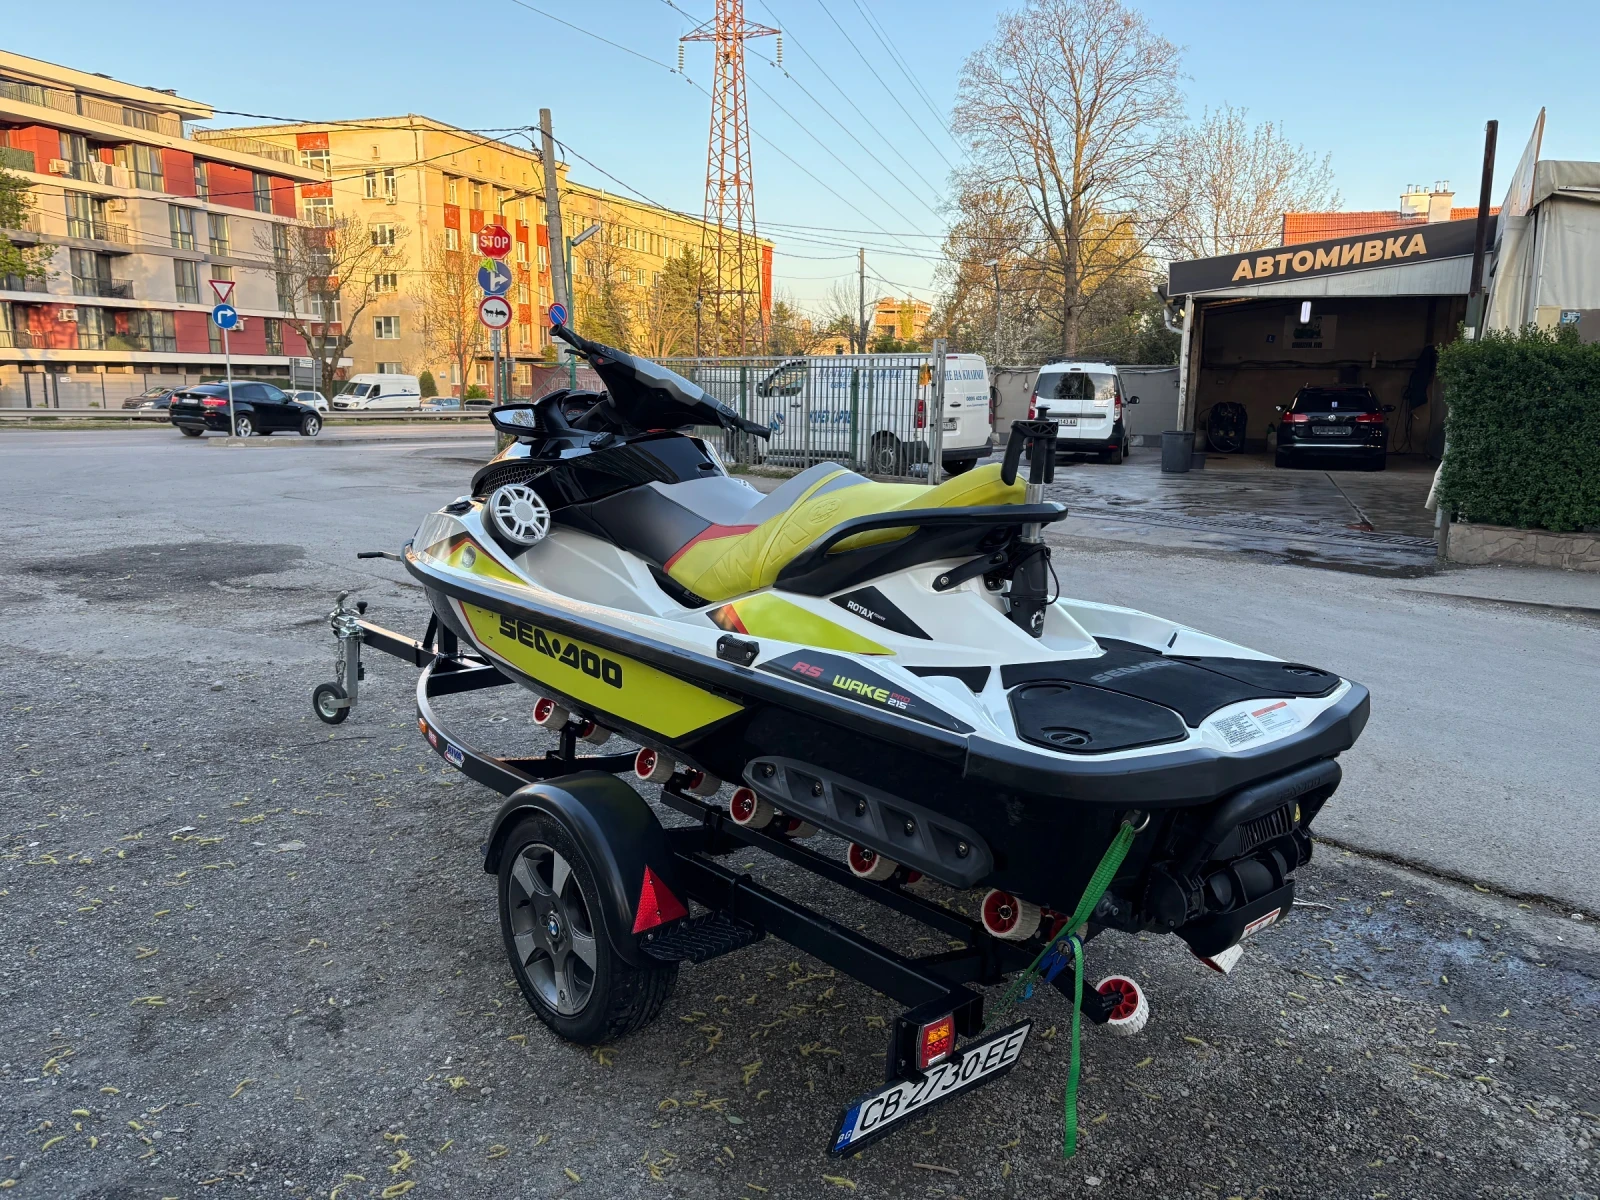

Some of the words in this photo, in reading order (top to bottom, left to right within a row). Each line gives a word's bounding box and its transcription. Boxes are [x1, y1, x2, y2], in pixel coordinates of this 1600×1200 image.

[480, 235, 509, 249] STOP
[1231, 233, 1427, 282] АВТОМИВКА
[847, 600, 875, 620] ROTAX
[792, 661, 824, 678] RS
[832, 674, 890, 703] WAKE
[891, 692, 911, 703] PRO
[887, 697, 908, 710] 215
[447, 744, 462, 761] RIVA
[860, 1089, 903, 1131] CB
[904, 1051, 981, 1111] 2730
[981, 1030, 1024, 1074] EE
[837, 1129, 852, 1144] BG
